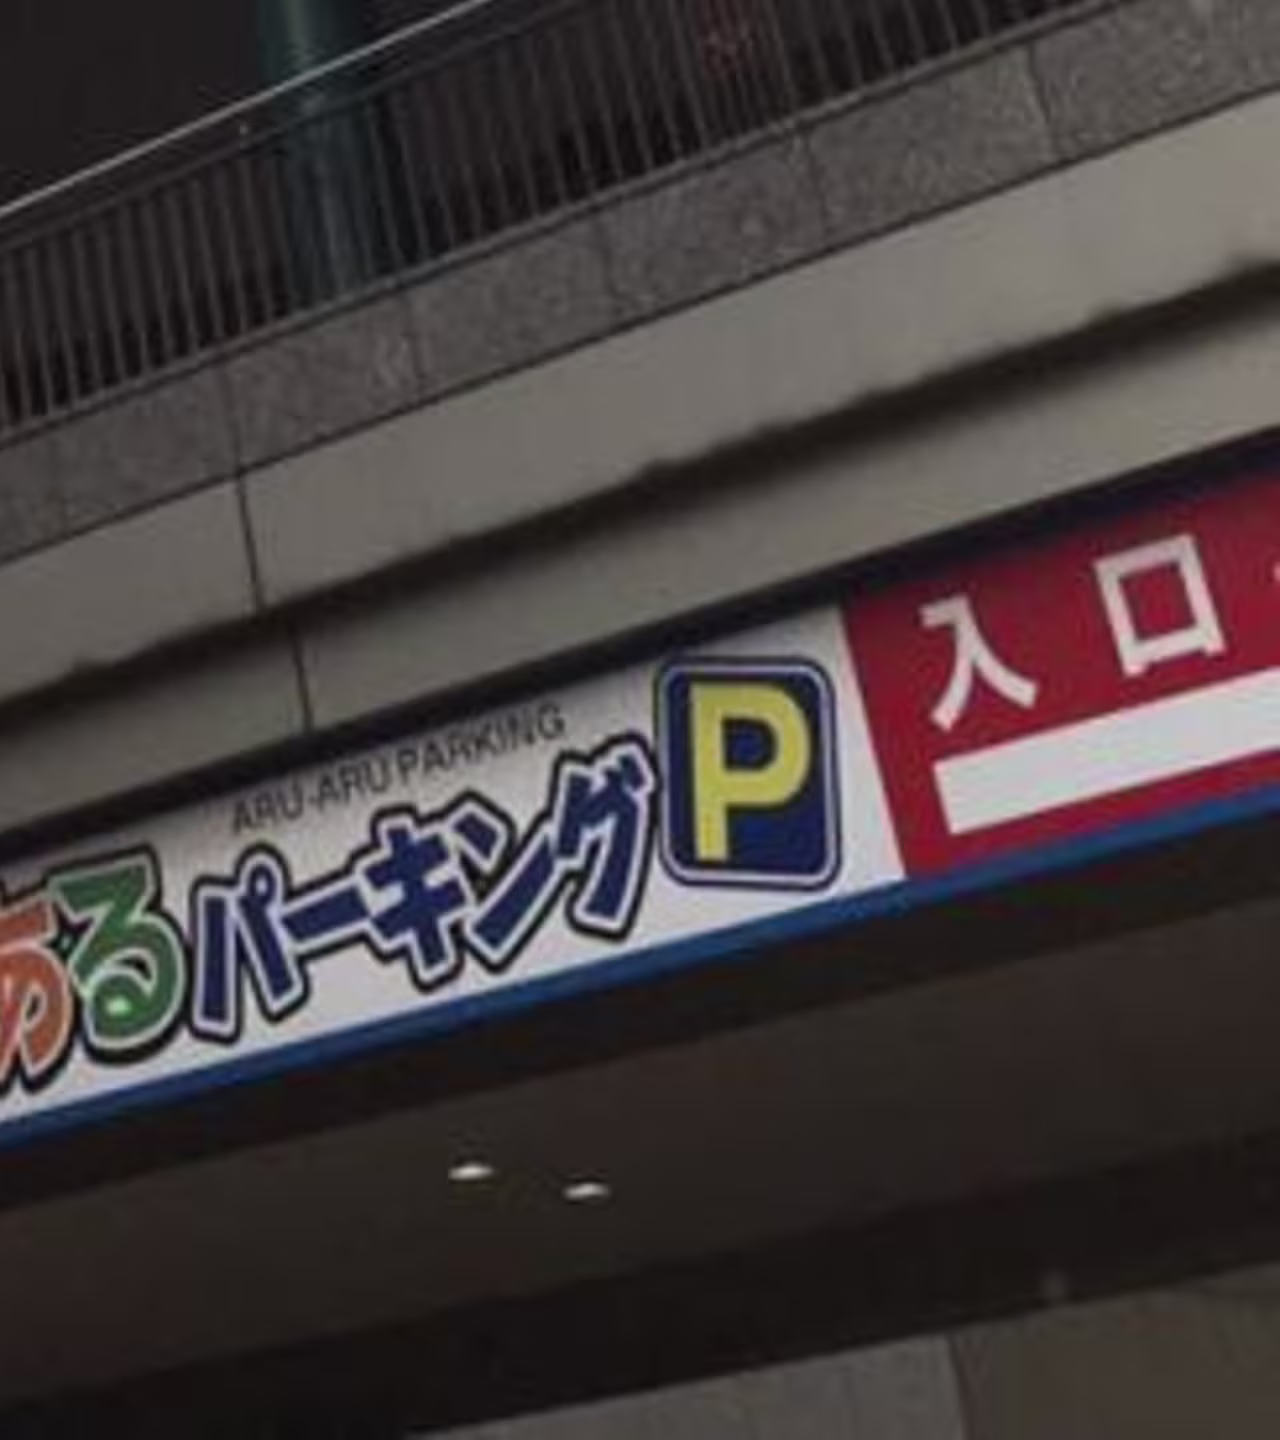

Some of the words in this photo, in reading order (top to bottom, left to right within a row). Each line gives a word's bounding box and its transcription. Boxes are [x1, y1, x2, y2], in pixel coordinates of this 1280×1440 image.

[232, 755, 391, 834] ARU-ARU
[395, 702, 566, 786] PARKING
[690, 681, 812, 862] P
